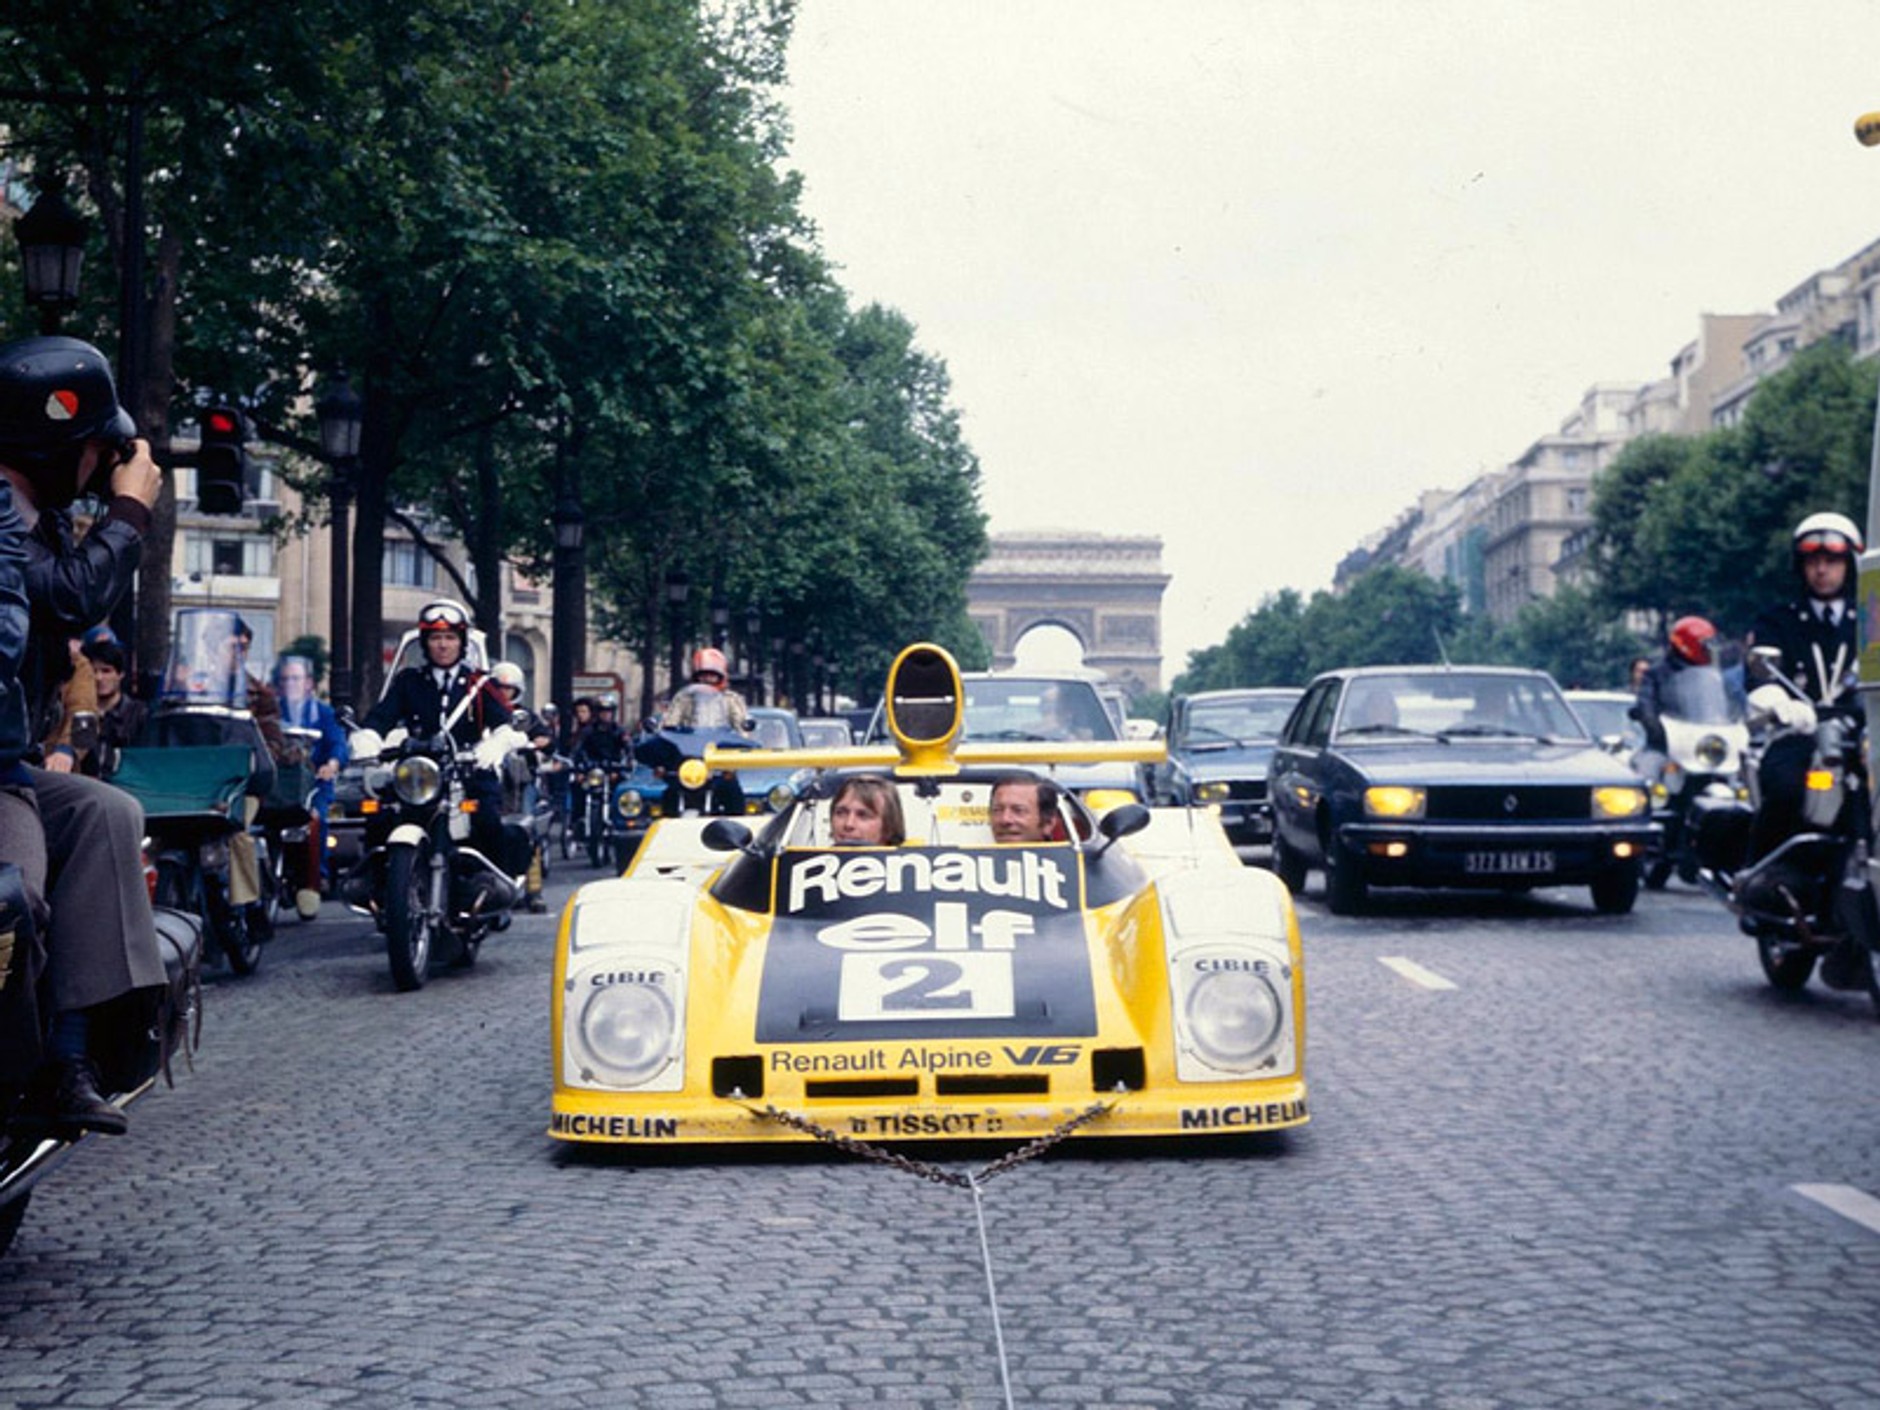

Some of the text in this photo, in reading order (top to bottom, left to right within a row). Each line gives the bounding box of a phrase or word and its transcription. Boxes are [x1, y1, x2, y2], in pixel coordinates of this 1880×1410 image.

[789, 851, 1068, 912] Renault
[817, 902, 1035, 950] elf
[879, 959, 972, 1010] 2
[771, 1045, 1082, 1072] Renault Alpine V6
[874, 1113, 980, 1134] TISSOT
